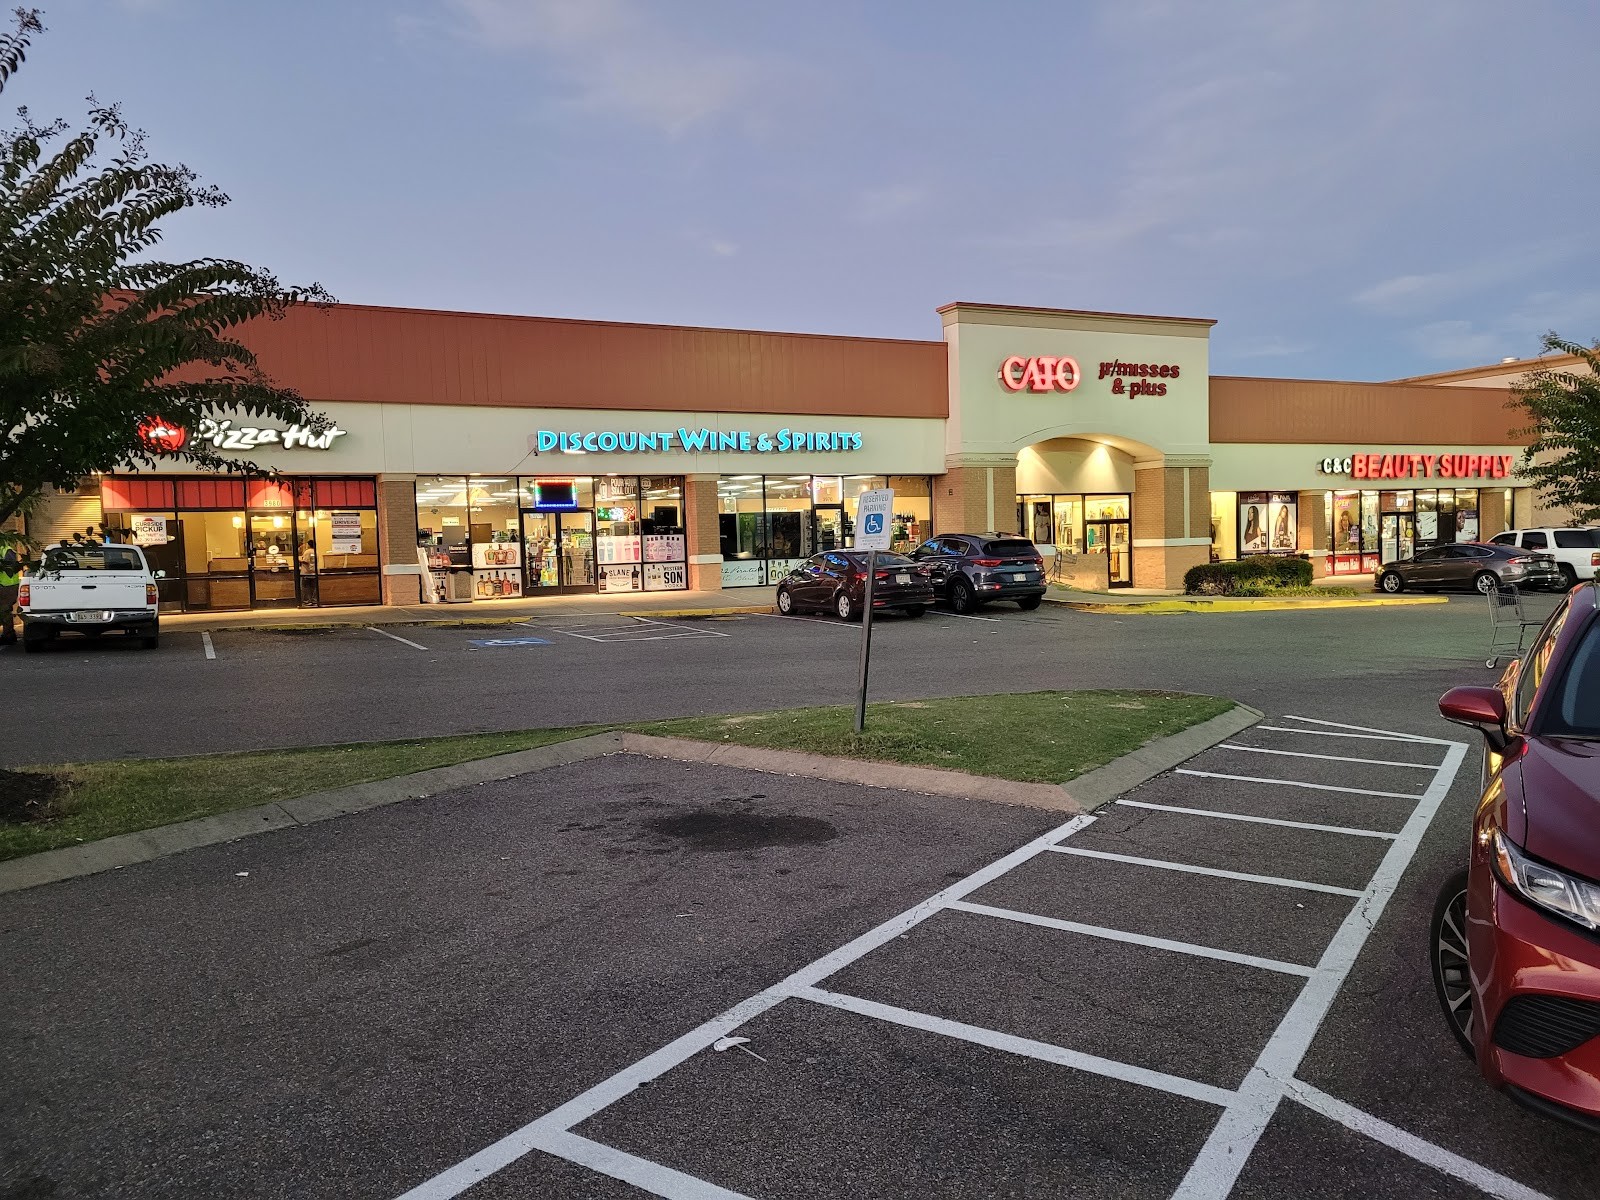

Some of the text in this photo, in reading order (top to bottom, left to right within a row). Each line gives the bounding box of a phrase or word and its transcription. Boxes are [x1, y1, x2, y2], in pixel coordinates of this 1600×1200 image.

[1001, 356, 1080, 391] CATO
[1098, 359, 1180, 379] jr/misses
[1111, 379, 1167, 399] & plus
[281, 424, 347, 450] Hut
[537, 427, 863, 452] DISCOUNT WINE & SPIRITS
[1322, 454, 1514, 479] C&C BEAUTY SUPPLY
[862, 493, 889, 504] RESERVED
[863, 504, 887, 513] PARKING
[608, 569, 631, 577] SLANE
[1363, 556, 1379, 573] Wigs
[663, 571, 684, 584] SON
